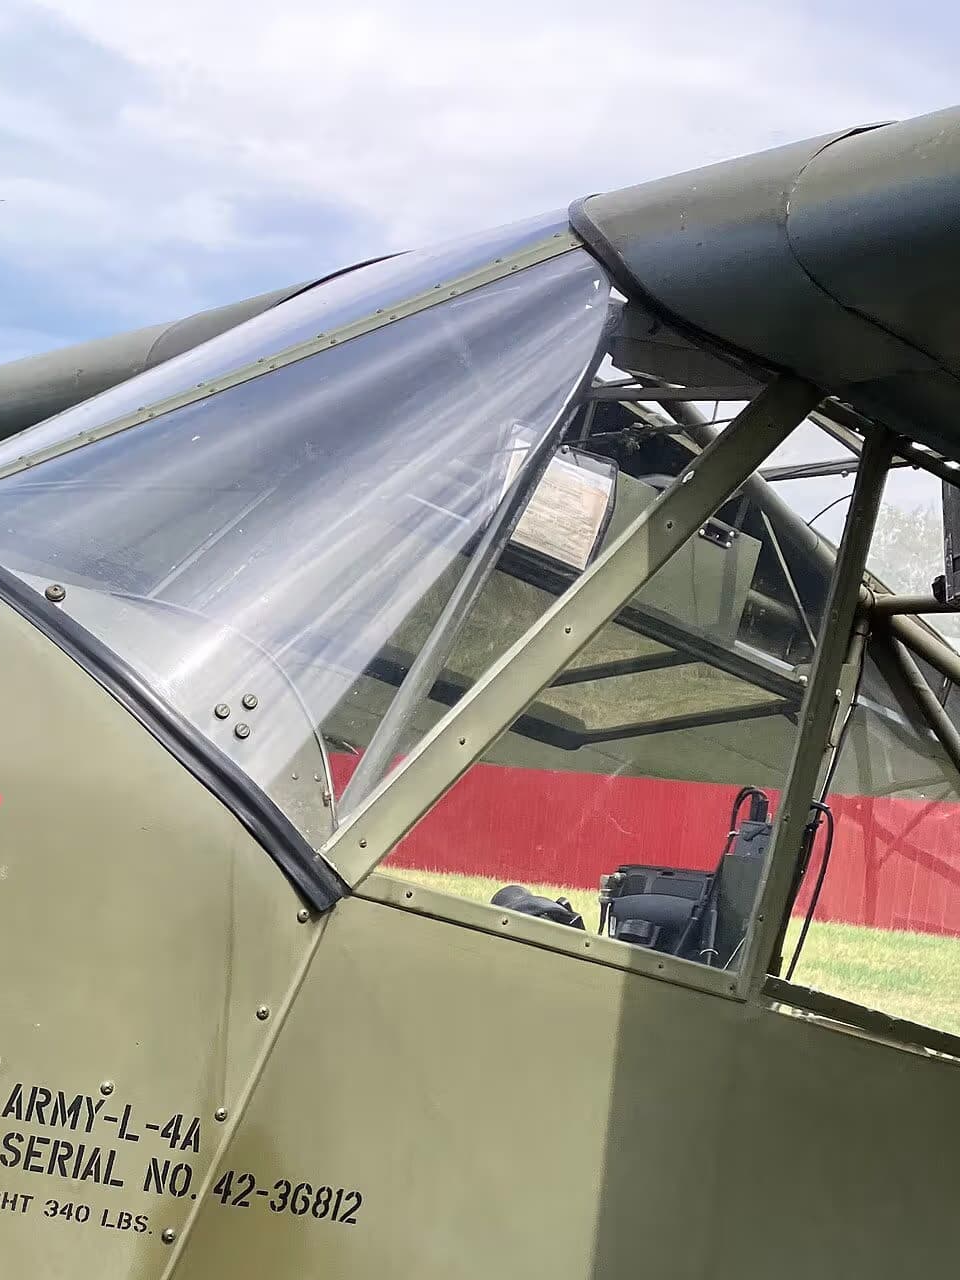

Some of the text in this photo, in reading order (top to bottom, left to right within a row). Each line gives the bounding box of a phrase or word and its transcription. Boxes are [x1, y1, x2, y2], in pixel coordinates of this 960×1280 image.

[1, 1083, 201, 1153] ARMY-L-4A
[0, 1131, 124, 1188] SERIAL
[143, 1157, 197, 1200] NO.
[212, 1169, 363, 1225] 42-36812
[43, 1199, 90, 1223] 340
[100, 1208, 153, 1235] LBS.
